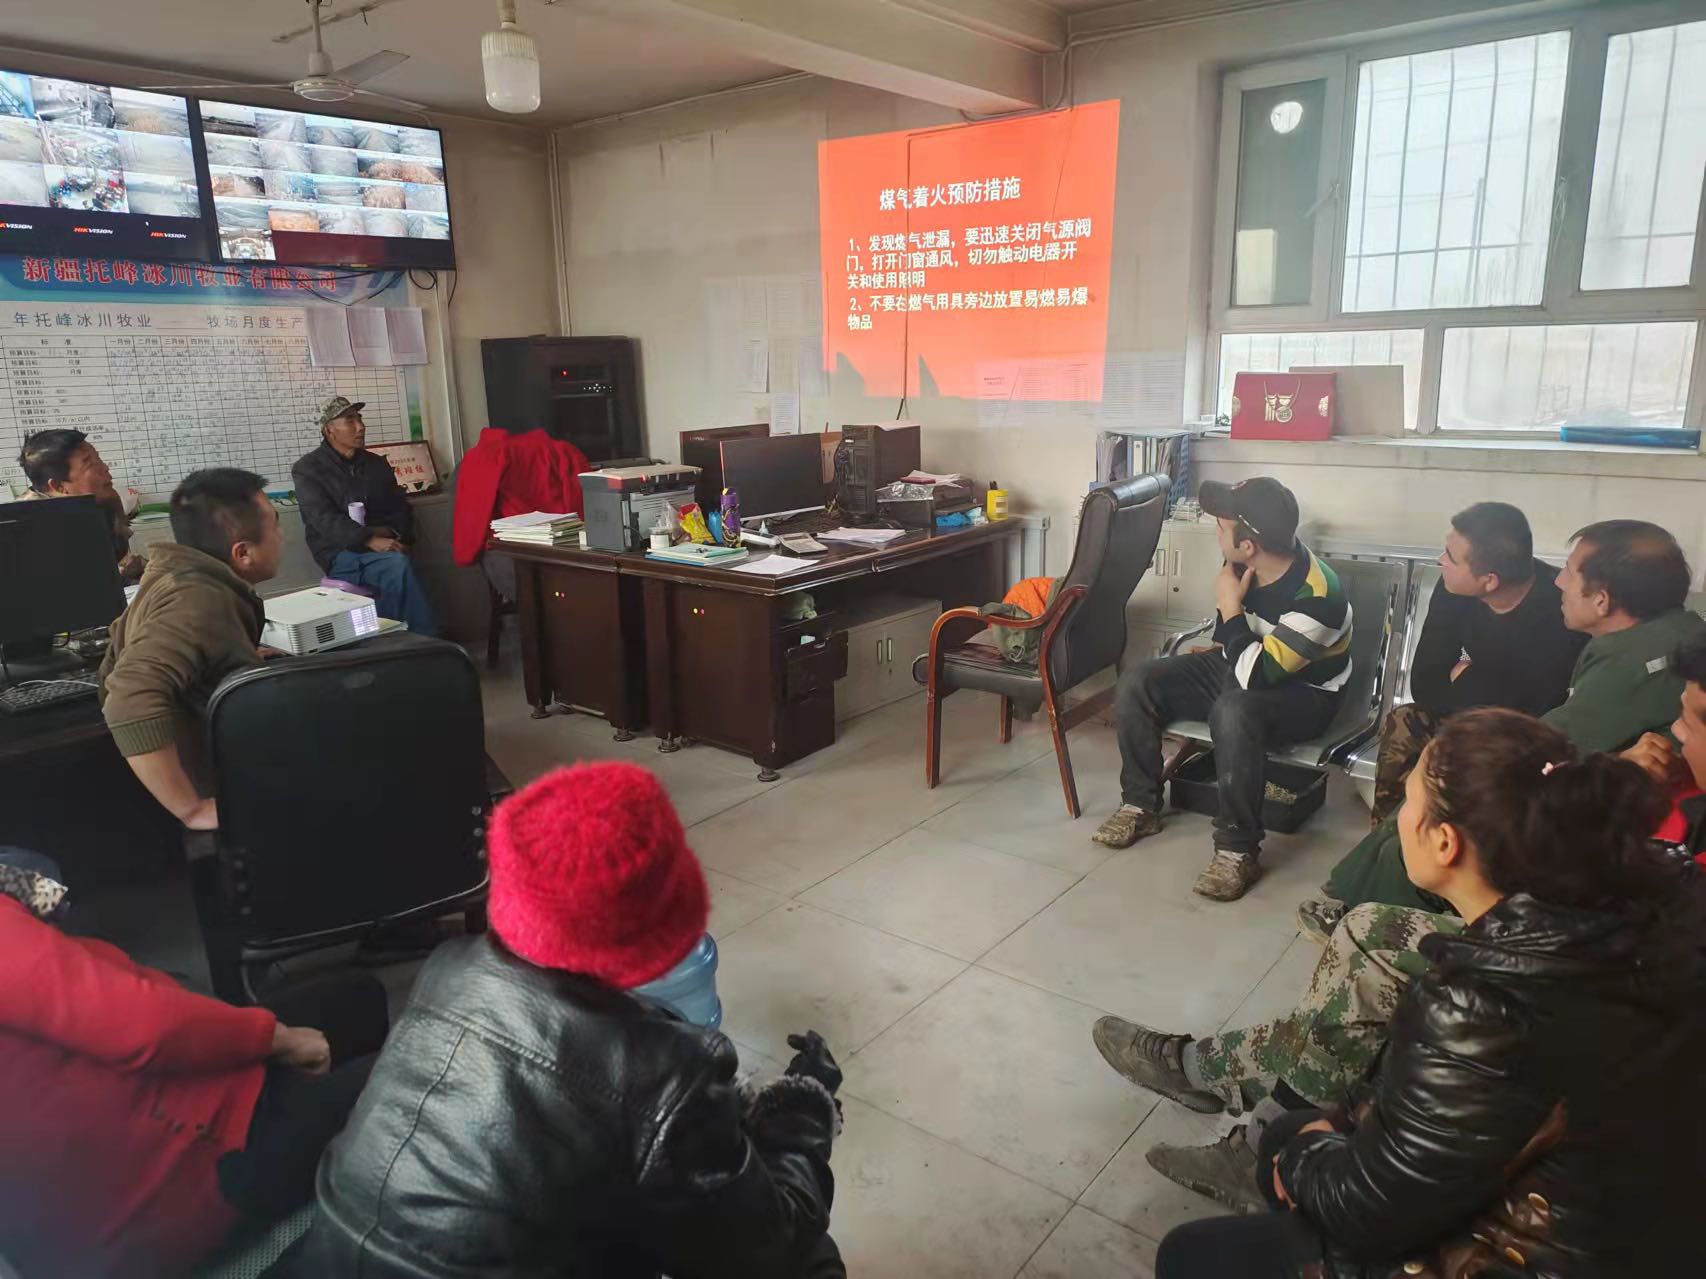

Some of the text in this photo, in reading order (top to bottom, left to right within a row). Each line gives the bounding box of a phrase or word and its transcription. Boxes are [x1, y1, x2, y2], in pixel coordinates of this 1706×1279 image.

[879, 176, 1021, 211] 煤气着火预防措施
[73, 227, 114, 235] HIKVISION
[150, 231, 187, 239] HIKVISION
[23, 255, 338, 292] 新疆托峰冰川牧业有限公司
[847, 270, 925, 290] 关和使用照明
[14, 311, 304, 329] 年托峰冰川牧业 牧场月度生产
[848, 314, 872, 330] 物品
